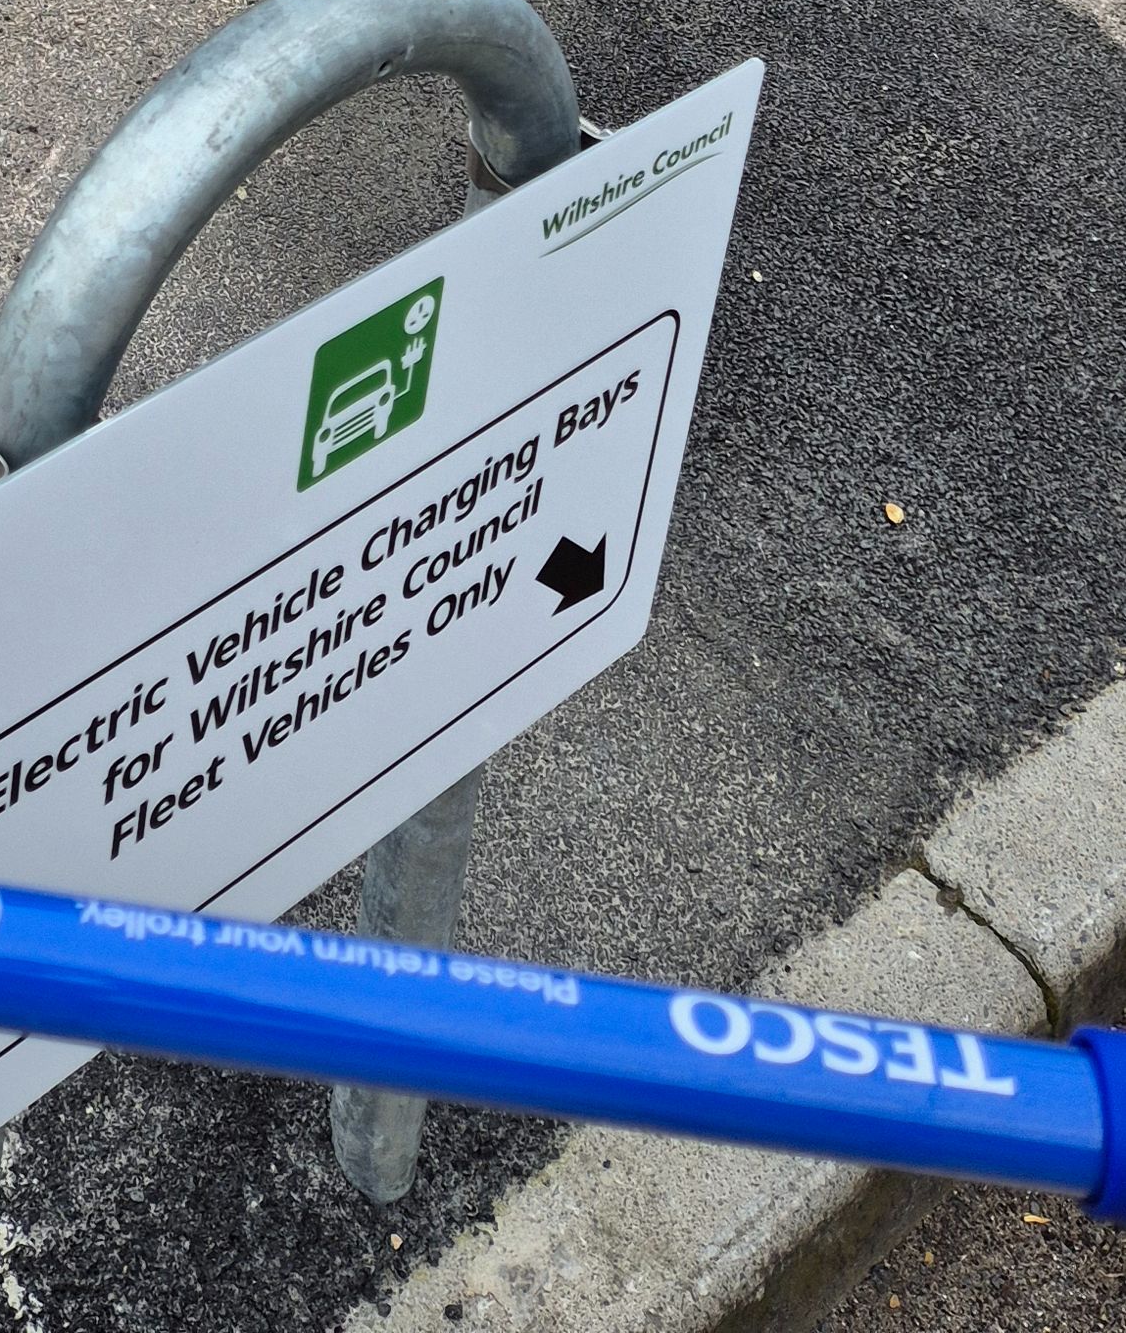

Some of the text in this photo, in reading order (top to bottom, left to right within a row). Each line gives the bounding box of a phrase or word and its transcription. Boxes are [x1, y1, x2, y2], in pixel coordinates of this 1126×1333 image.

[542, 111, 734, 240] Wiltshire Council
[186, 564, 346, 686] Vehicle
[360, 434, 541, 573] Charging
[552, 369, 642, 449] Bays
[102, 477, 545, 806] for Wiltshire Council
[110, 555, 518, 861] Fleet Vehicles Only
[73, 900, 581, 1006] Please return your trolley.
[669, 993, 1017, 1096] TESCO
